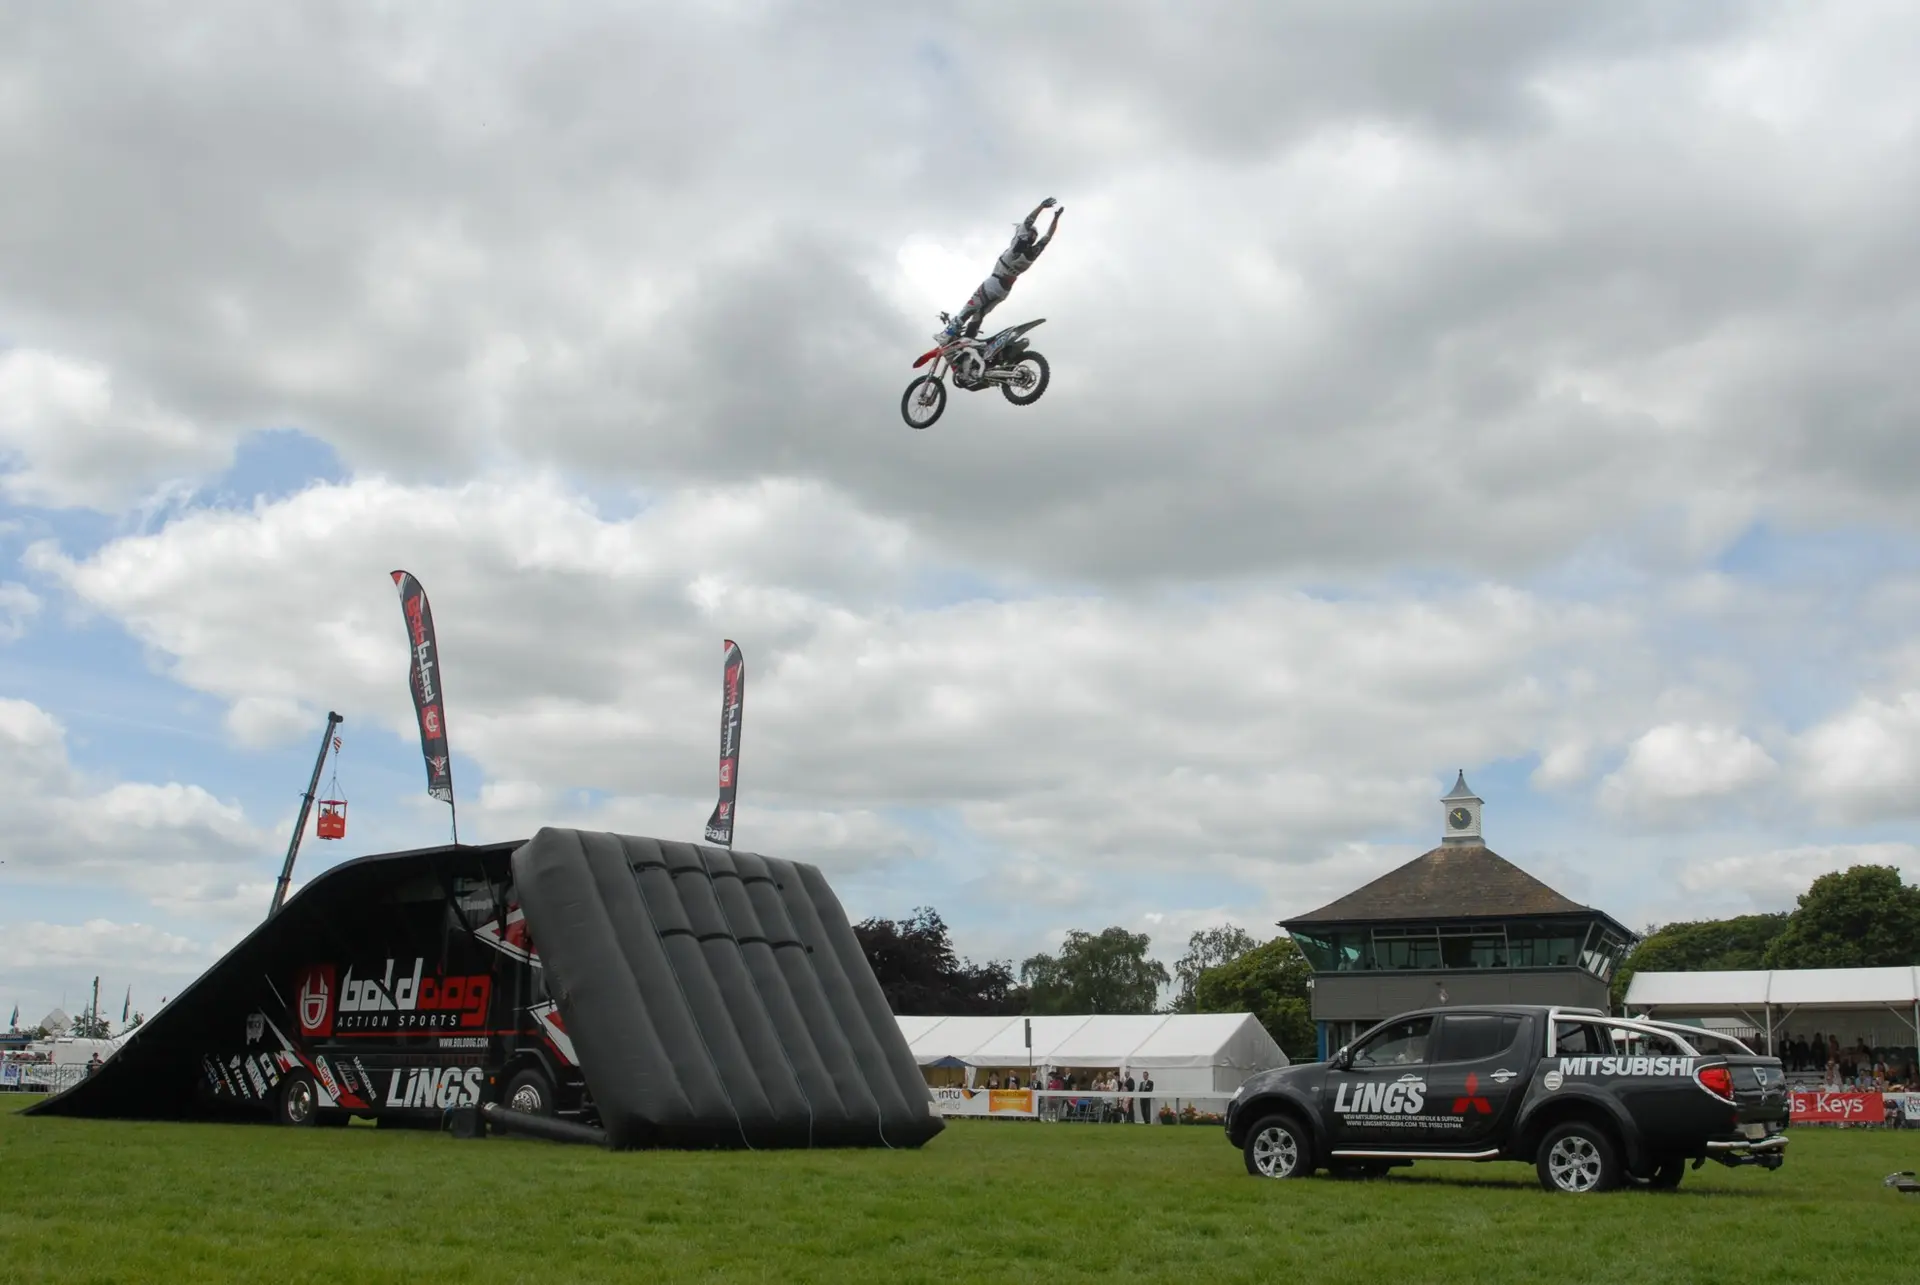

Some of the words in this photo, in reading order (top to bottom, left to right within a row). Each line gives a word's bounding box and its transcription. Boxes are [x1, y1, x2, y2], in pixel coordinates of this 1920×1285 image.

[337, 1015, 389, 1027] ACTION
[398, 1014, 457, 1027] SPORTS
[1559, 1057, 1695, 1076] MITSUBISHI
[938, 1089, 960, 1099] intu
[1817, 1091, 1864, 1119] Keys
